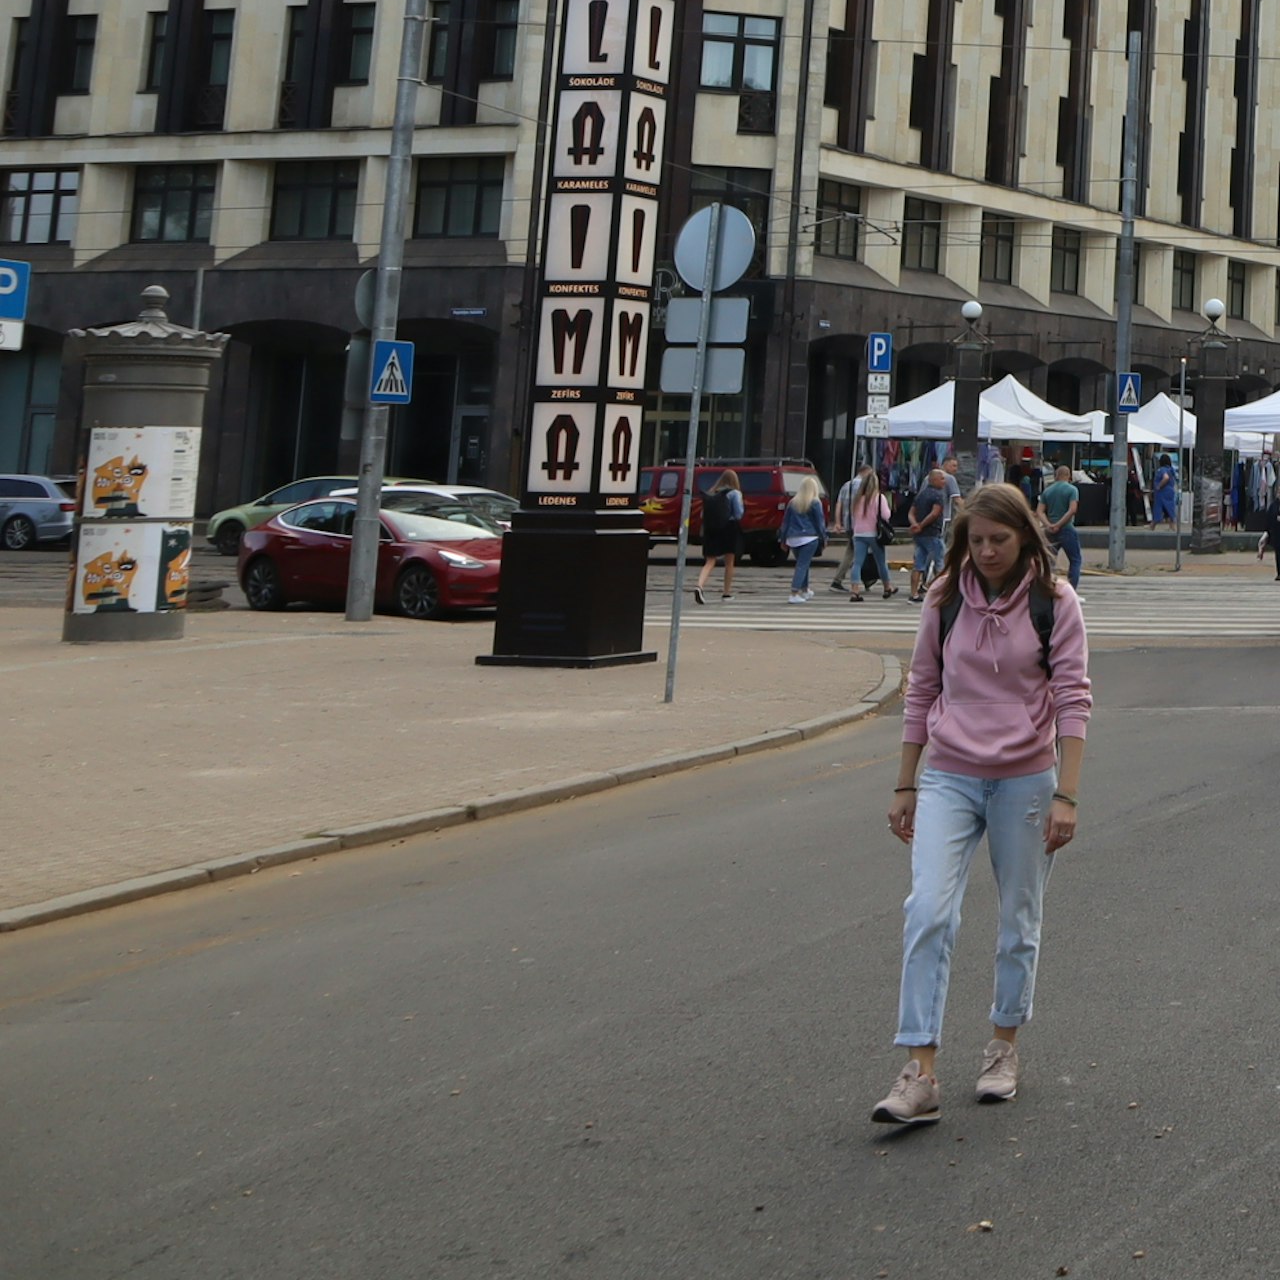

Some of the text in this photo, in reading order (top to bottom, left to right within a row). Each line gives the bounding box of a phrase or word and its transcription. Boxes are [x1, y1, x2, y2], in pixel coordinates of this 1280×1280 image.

[557, 180, 609, 189] KARAMELES
[549, 285, 599, 293] KONFEKTES
[873, 337, 886, 367] P
[538, 496, 576, 506] LEDENES
